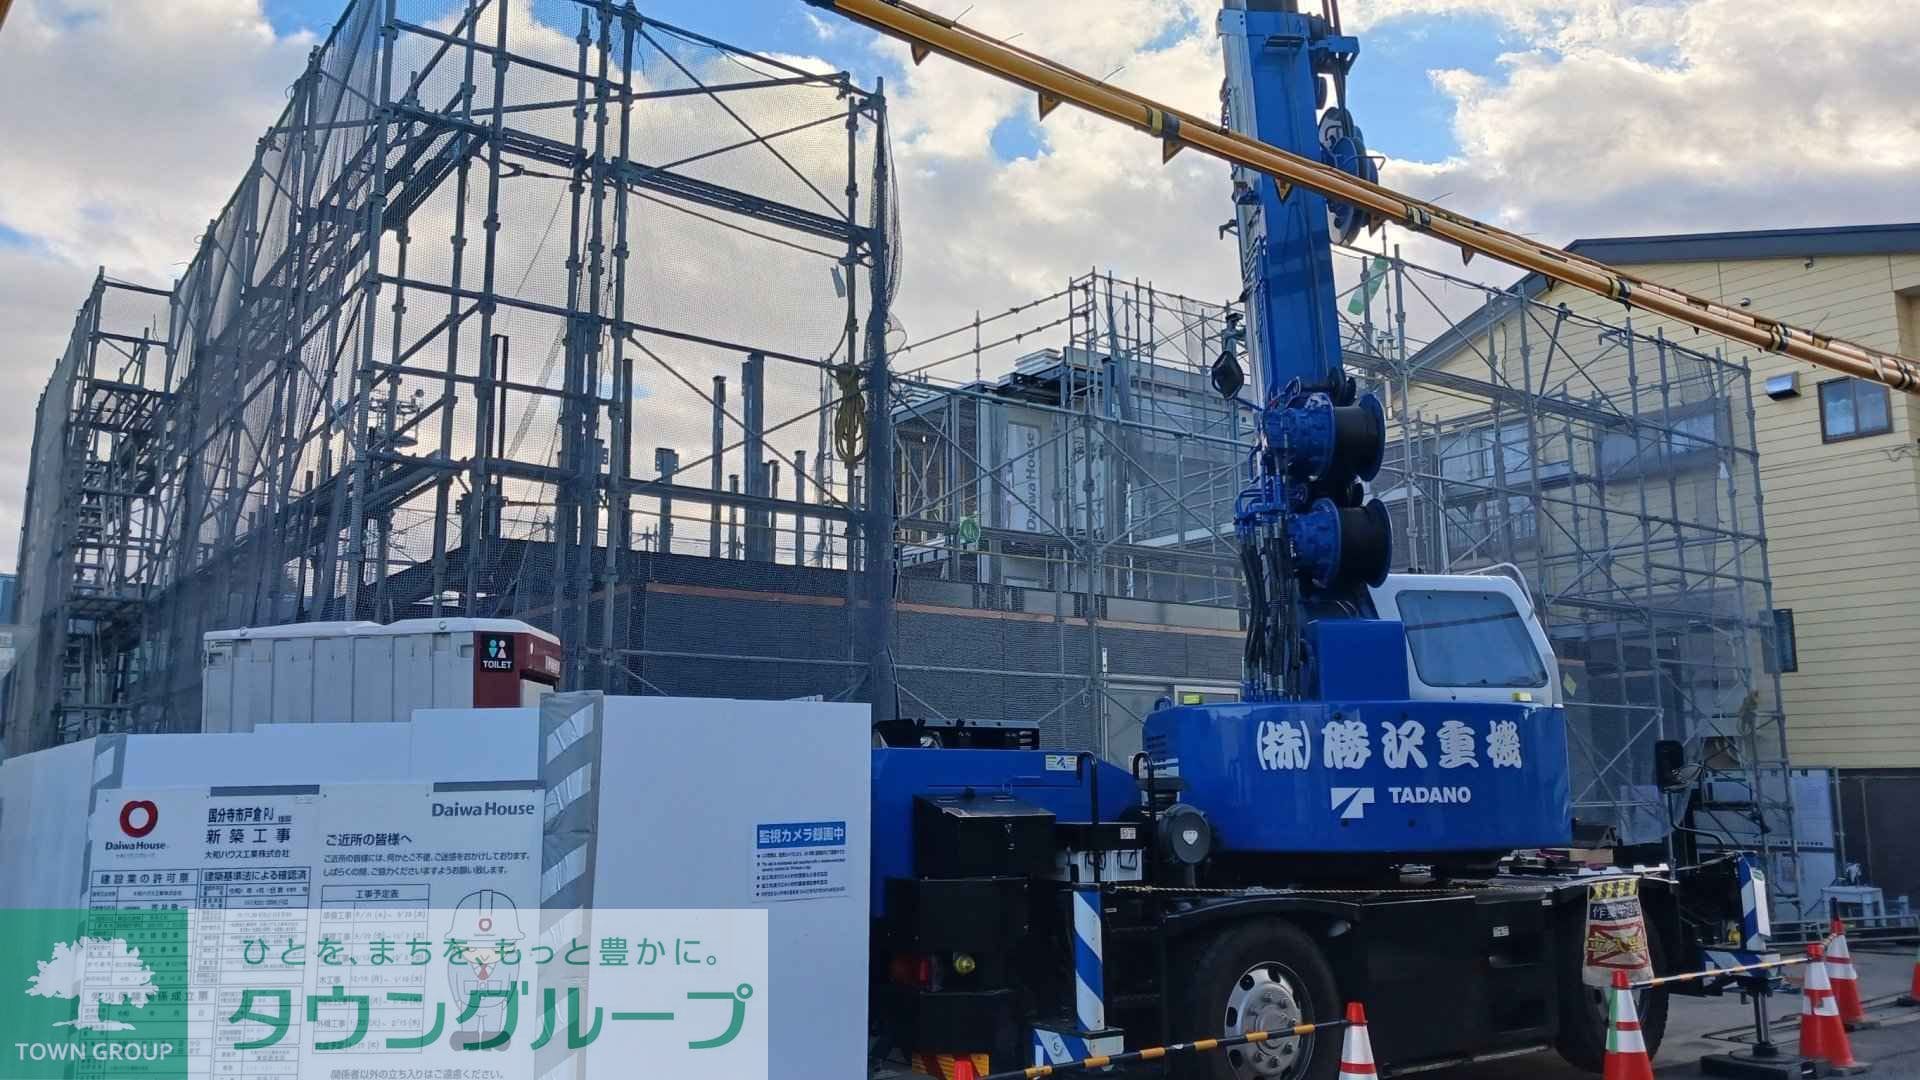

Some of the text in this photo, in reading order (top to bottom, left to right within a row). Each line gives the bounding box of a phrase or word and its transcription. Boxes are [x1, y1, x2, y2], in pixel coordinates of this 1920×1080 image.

[482, 660, 512, 669] TOILET
[1389, 787, 1471, 803] TADANO
[206, 828, 291, 844] 新築工事
[325, 833, 413, 847] ご近所の皆様へ
